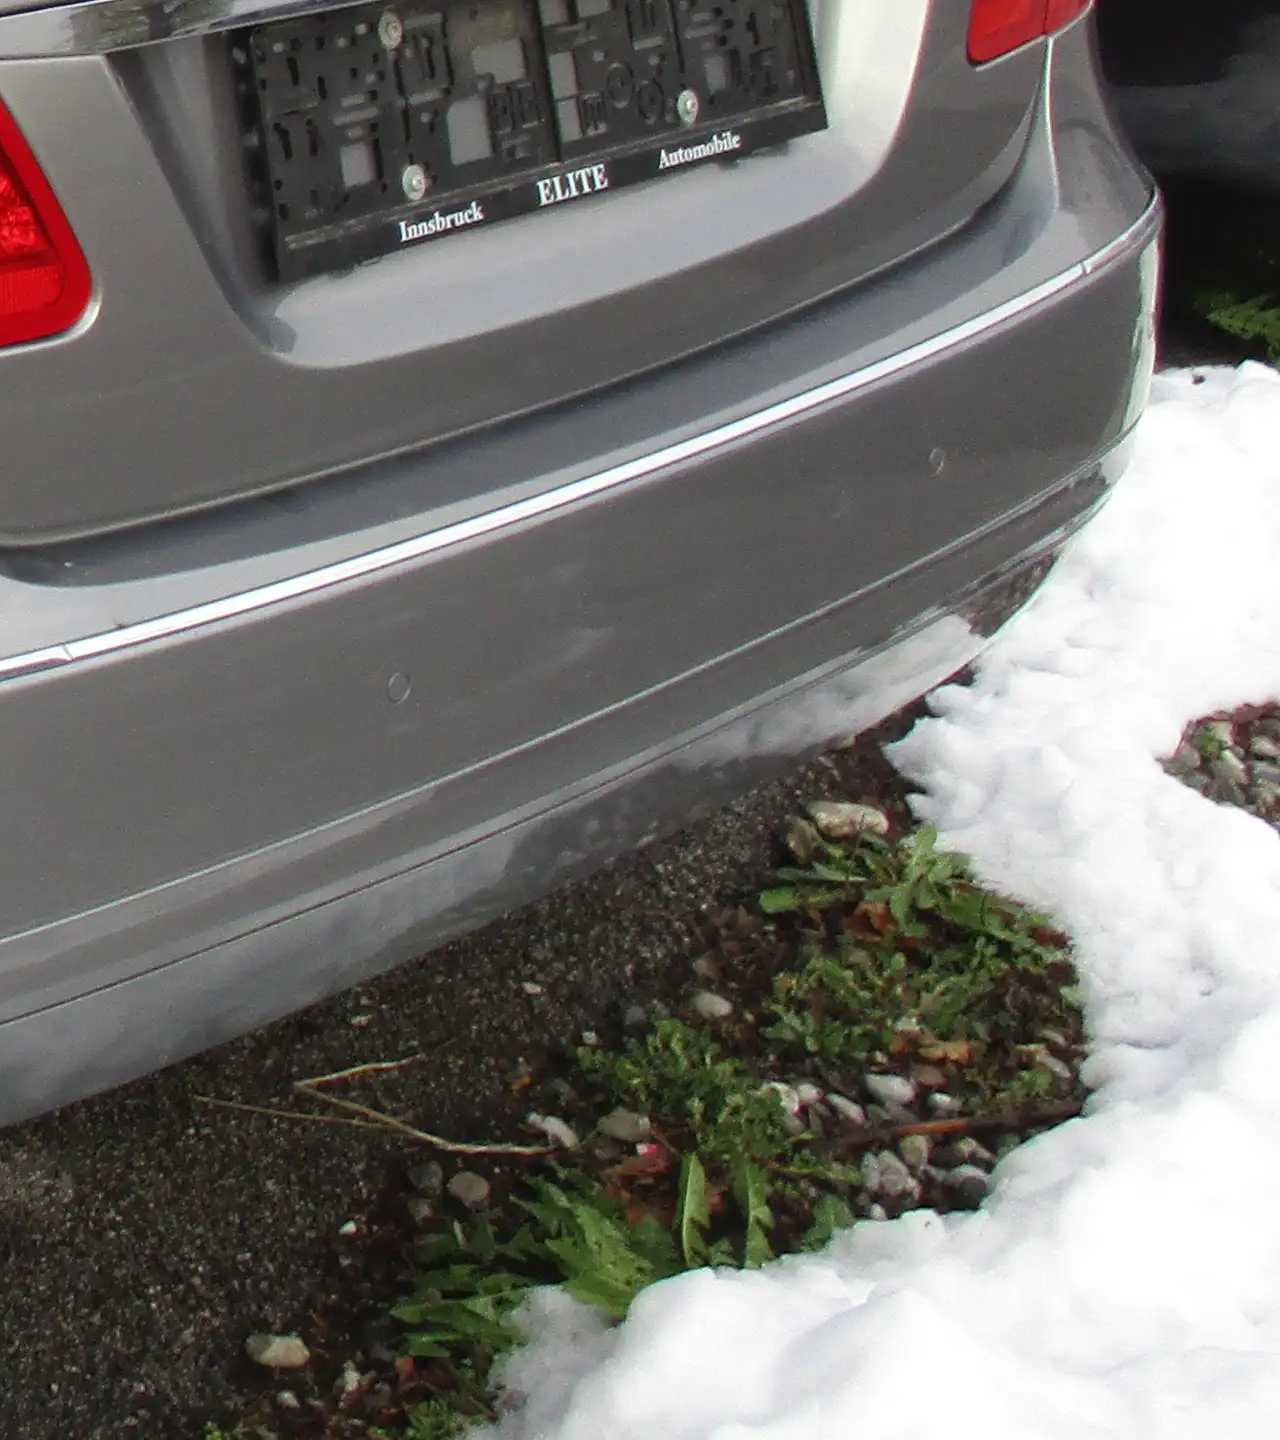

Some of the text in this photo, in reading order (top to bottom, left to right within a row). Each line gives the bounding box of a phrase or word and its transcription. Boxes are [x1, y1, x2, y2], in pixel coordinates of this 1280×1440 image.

[399, 130, 741, 244] Innsbruck ELITE Automobile
